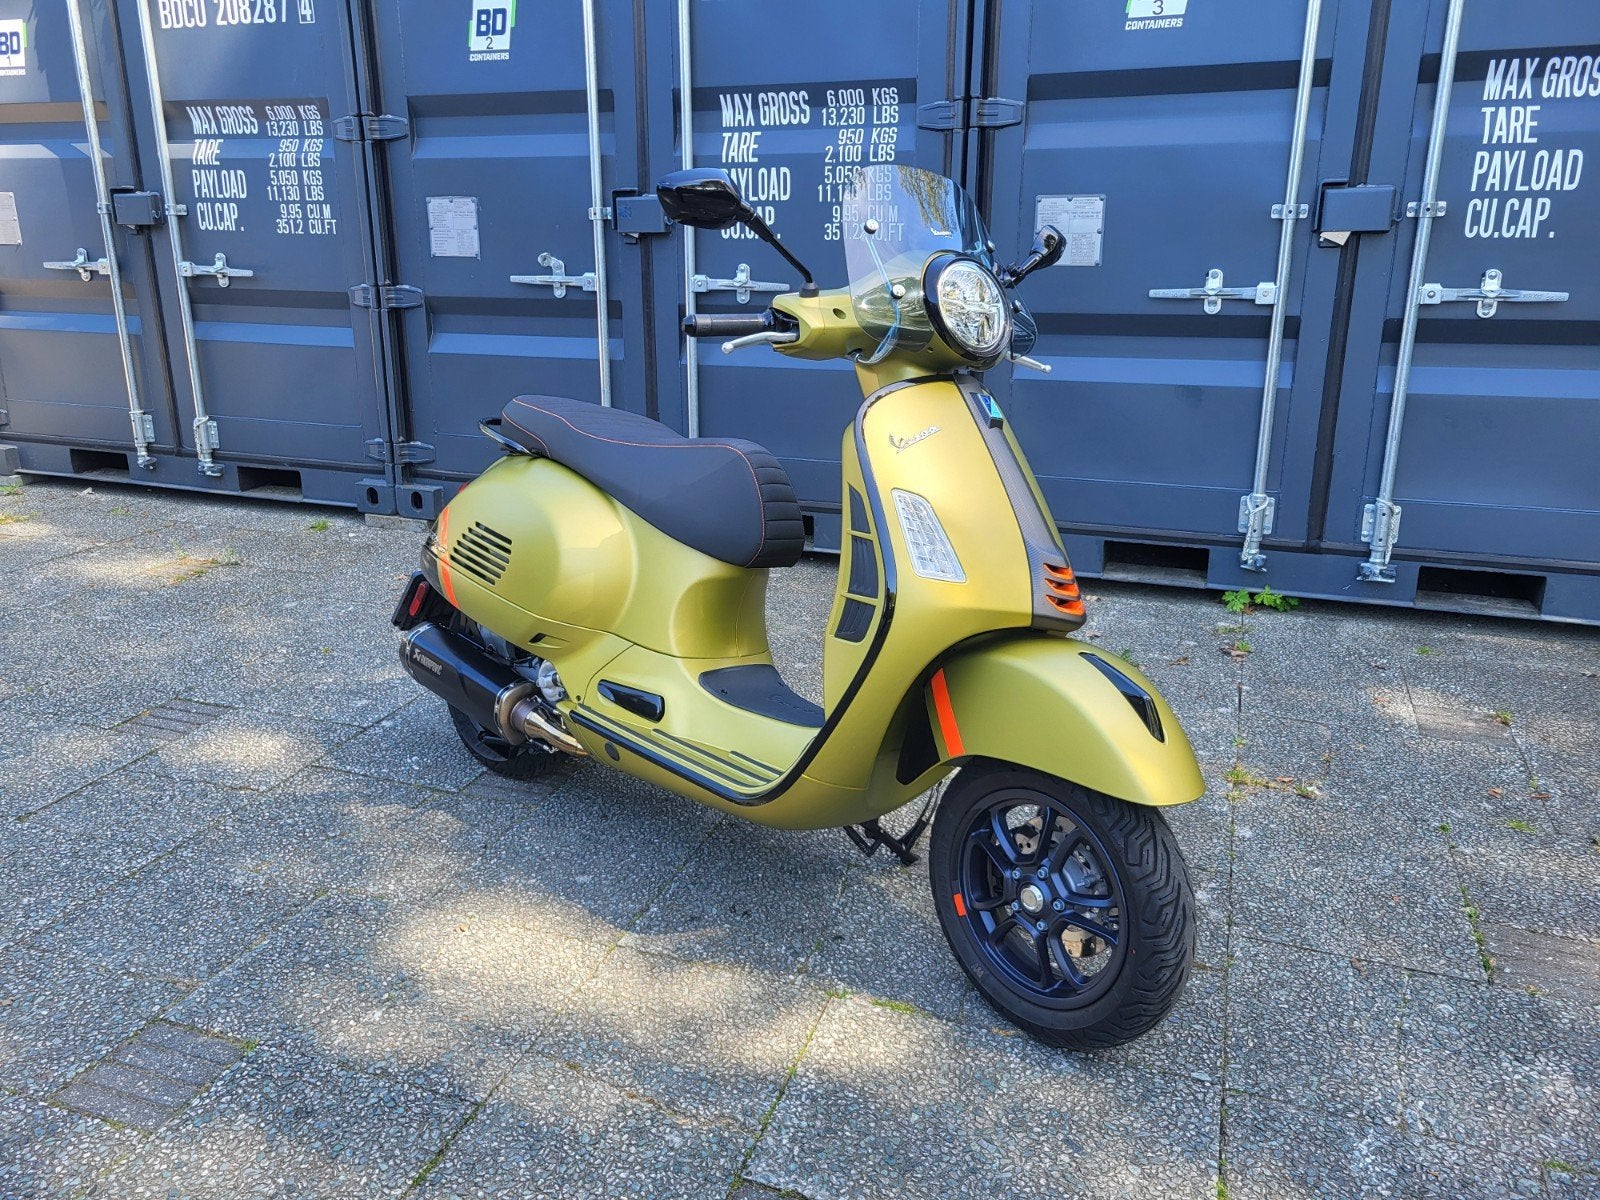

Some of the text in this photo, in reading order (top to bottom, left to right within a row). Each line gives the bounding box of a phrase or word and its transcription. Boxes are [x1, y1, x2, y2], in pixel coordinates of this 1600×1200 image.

[158, 0, 207, 29] BDCU
[1152, 0, 1164, 15] 3
[476, 8, 507, 36] BD
[1125, 18, 1183, 30] CONTAINERS
[486, 37, 493, 49] 2
[470, 53, 509, 62] CONTAINERS
[1483, 57, 1540, 100] MAX
[872, 87, 899, 105] KGS
[265, 105, 321, 121] 6,000 KGS
[719, 90, 810, 127] MAX GROSS
[822, 105, 899, 126] 13,230 LBS
[186, 105, 259, 135] MAX GROSS
[265, 120, 323, 137] 13,230 LBS
[1481, 105, 1541, 144] TARE
[838, 127, 898, 145] 950 KGS
[192, 139, 224, 165] TARE
[278, 139, 323, 152] 950 KGS
[721, 132, 762, 163] TARE
[870, 144, 895, 162] LBS
[269, 152, 320, 168] 2,100 LBS
[270, 170, 322, 186] 5,050 KGS
[867, 164, 892, 183] KGS
[1470, 149, 1584, 192] PAYLOAD
[192, 169, 247, 199] PAYLOAD
[267, 185, 324, 201] 11,130 LBS
[867, 184, 892, 201] LBS
[280, 204, 331, 219] 9.95 CU.M
[276, 220, 337, 235] 351.2 CU.FT
